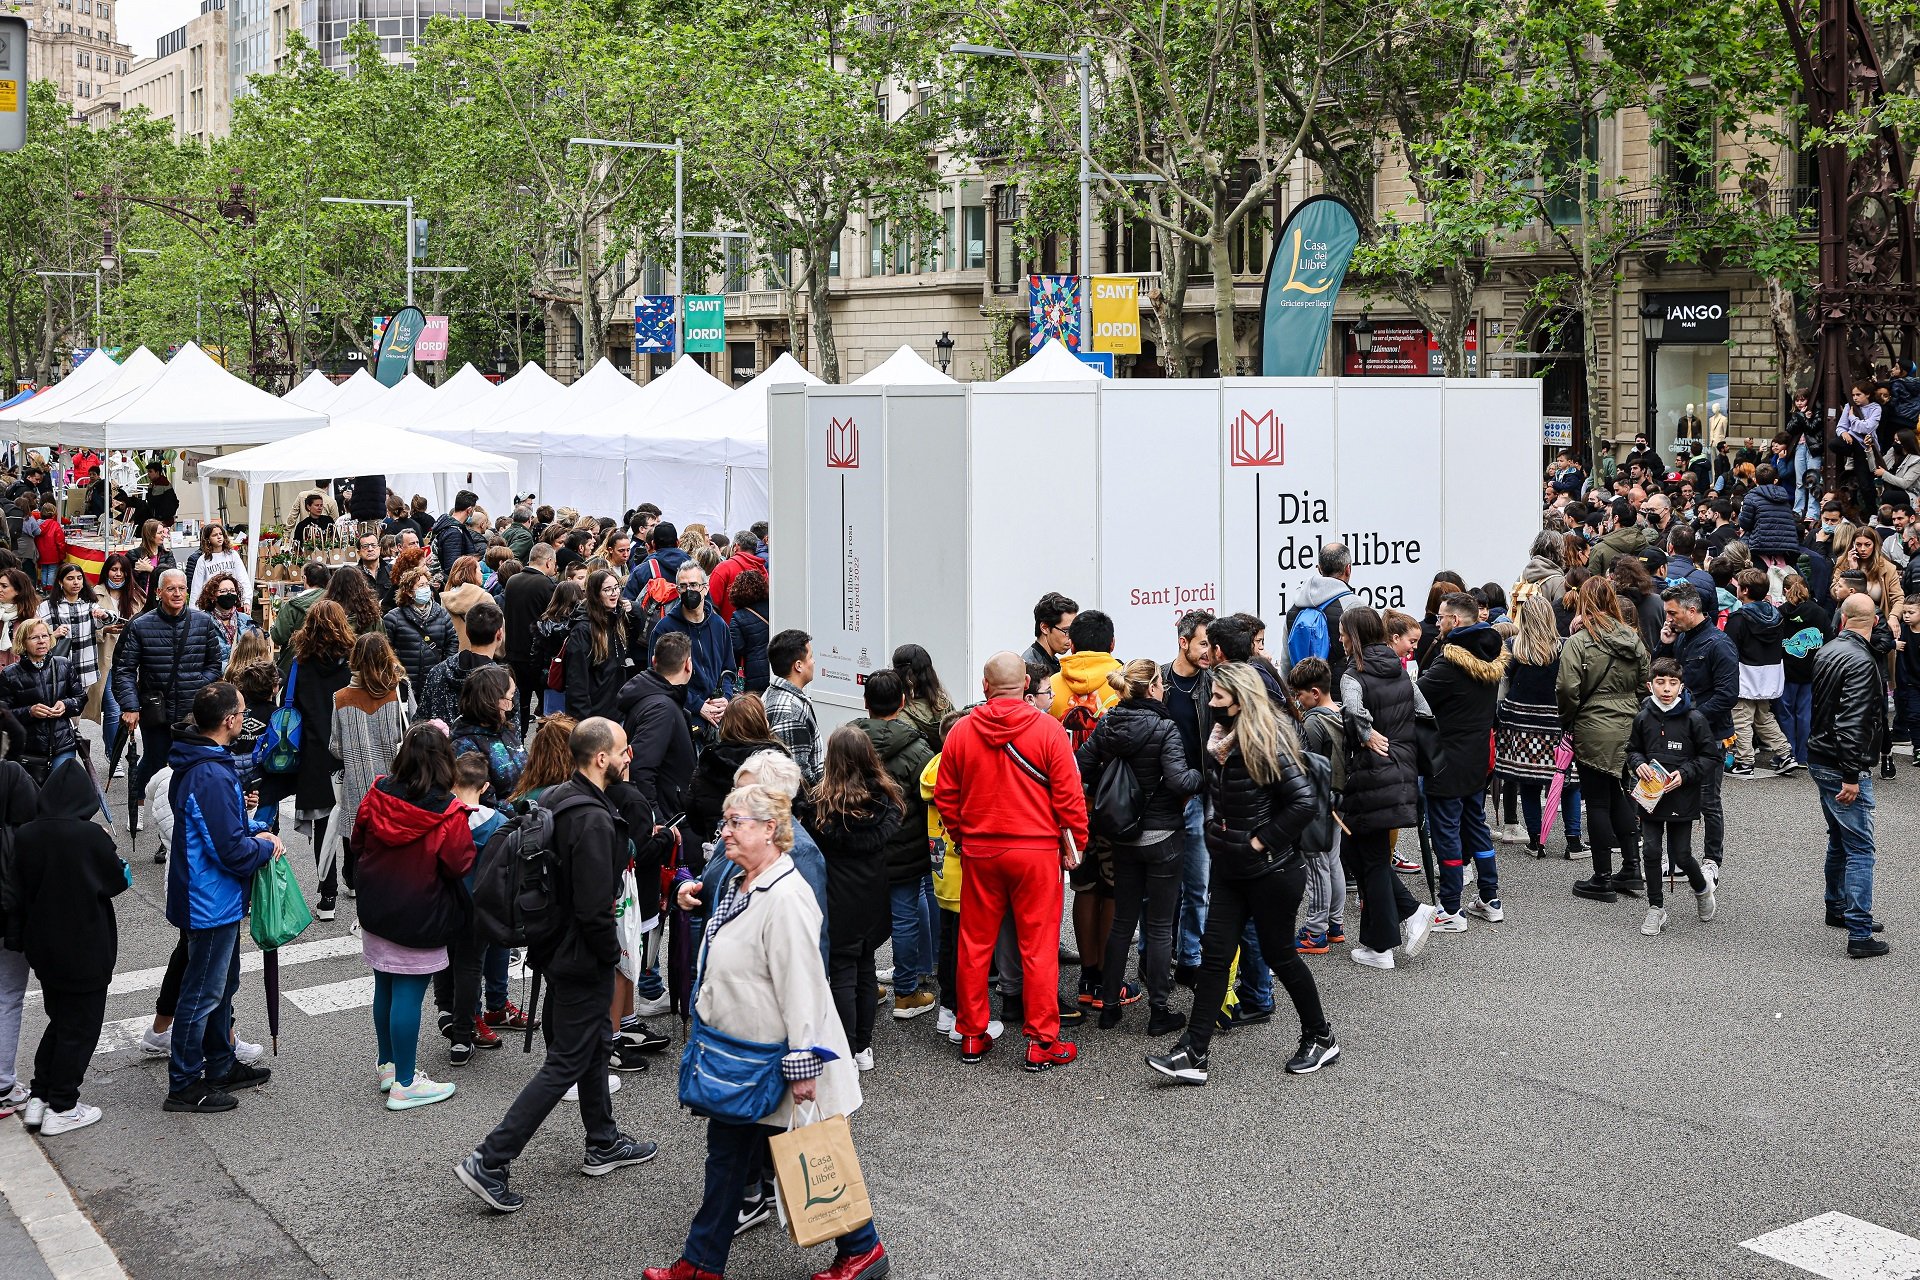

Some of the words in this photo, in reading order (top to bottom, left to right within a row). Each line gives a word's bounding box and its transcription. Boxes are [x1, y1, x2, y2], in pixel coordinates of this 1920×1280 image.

[1303, 239, 1328, 251] Casa
[1314, 252, 1328, 260] del
[1299, 258, 1327, 270] Llibre
[1096, 284, 1135, 299] SANT
[688, 300, 721, 312] SANT
[1280, 299, 1304, 307] Gràcies
[1666, 304, 1722, 320] ANGO
[425, 320, 446, 329] ANT
[1094, 322, 1137, 337] JORDI
[686, 328, 722, 340] JORDI
[416, 341, 446, 351] JORDI
[1278, 490, 1329, 525] Dia
[1278, 535, 1322, 570] del
[1130, 587, 1171, 606] Sant
[1173, 583, 1216, 607] Jordi
[1278, 583, 1287, 616] i
[1350, 583, 1405, 610] osa
[809, 1155, 832, 1168] Casa
[822, 1162, 835, 1173] del
[811, 1171, 836, 1186] Llibre
